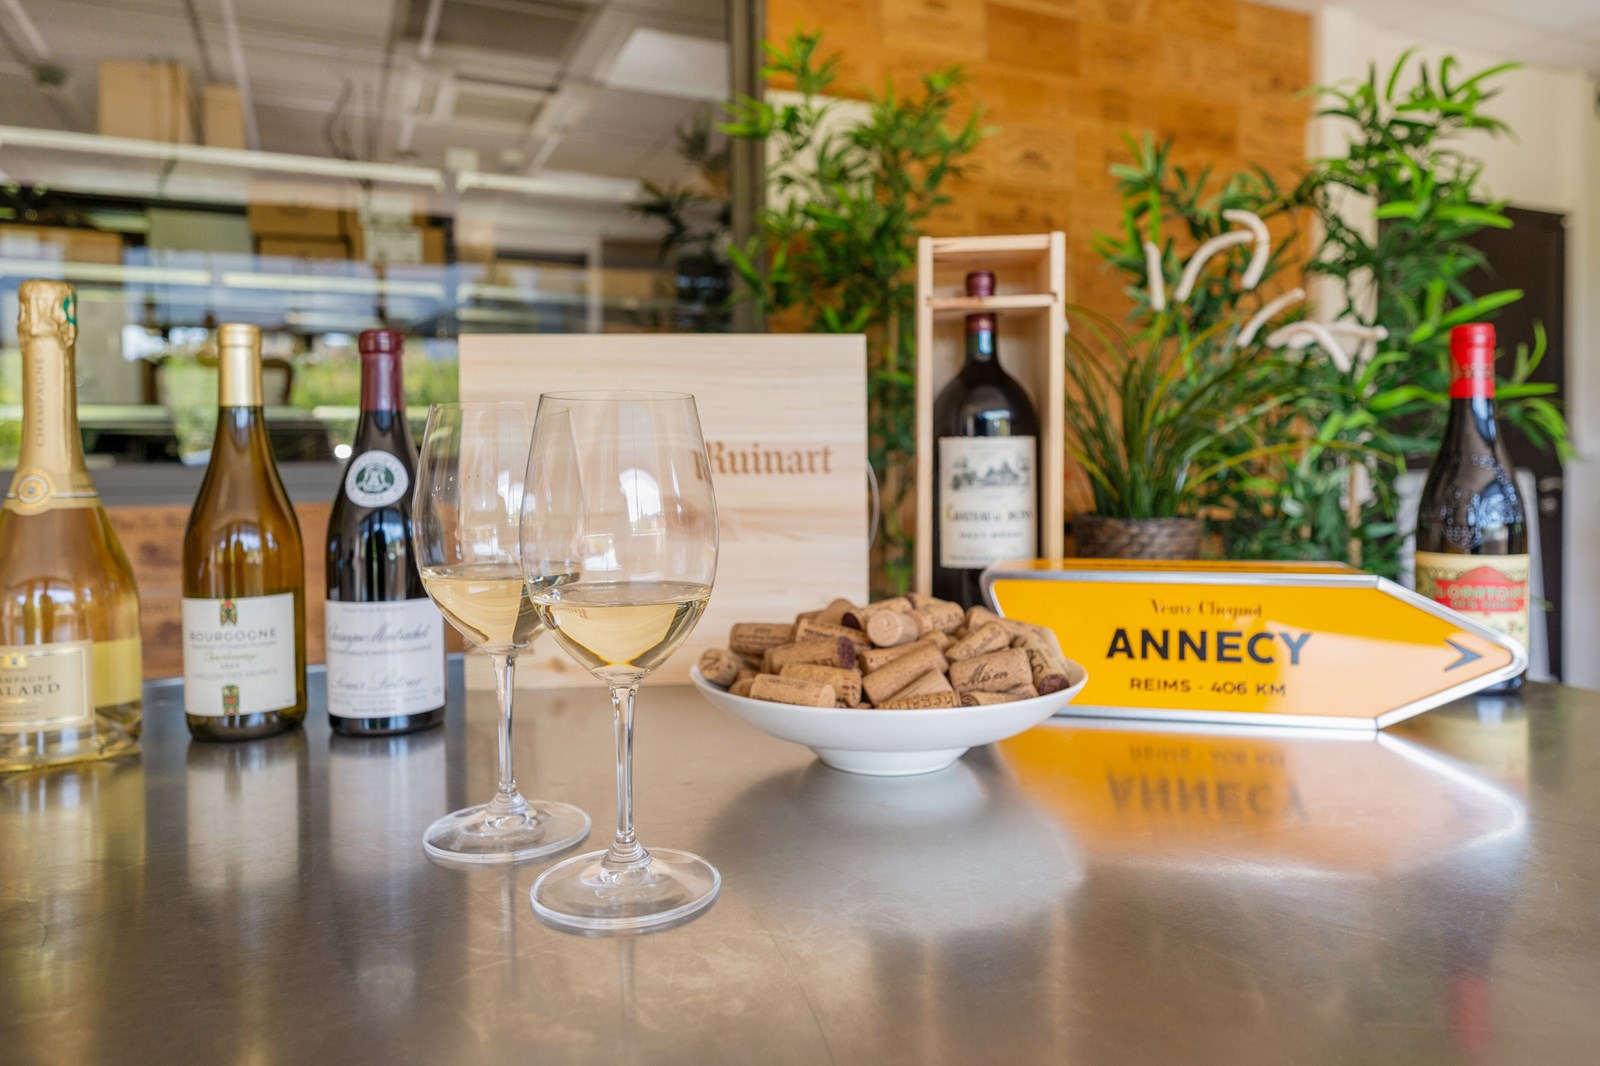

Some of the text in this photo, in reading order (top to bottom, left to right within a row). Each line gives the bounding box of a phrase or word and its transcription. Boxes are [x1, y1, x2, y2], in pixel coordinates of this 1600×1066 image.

[36, 357, 45, 448] CHAMPAGNE
[704, 441, 833, 475] Ruinart
[1151, 598, 1263, 619] Veuve Clicquot
[189, 627, 278, 643] BOURGOGNE
[1107, 628, 1312, 666] ANNECY
[0, 683, 61, 696] LARD
[1129, 678, 1192, 693] REIMS
[1211, 681, 1248, 695] 406
[1256, 685, 1286, 696] KM
